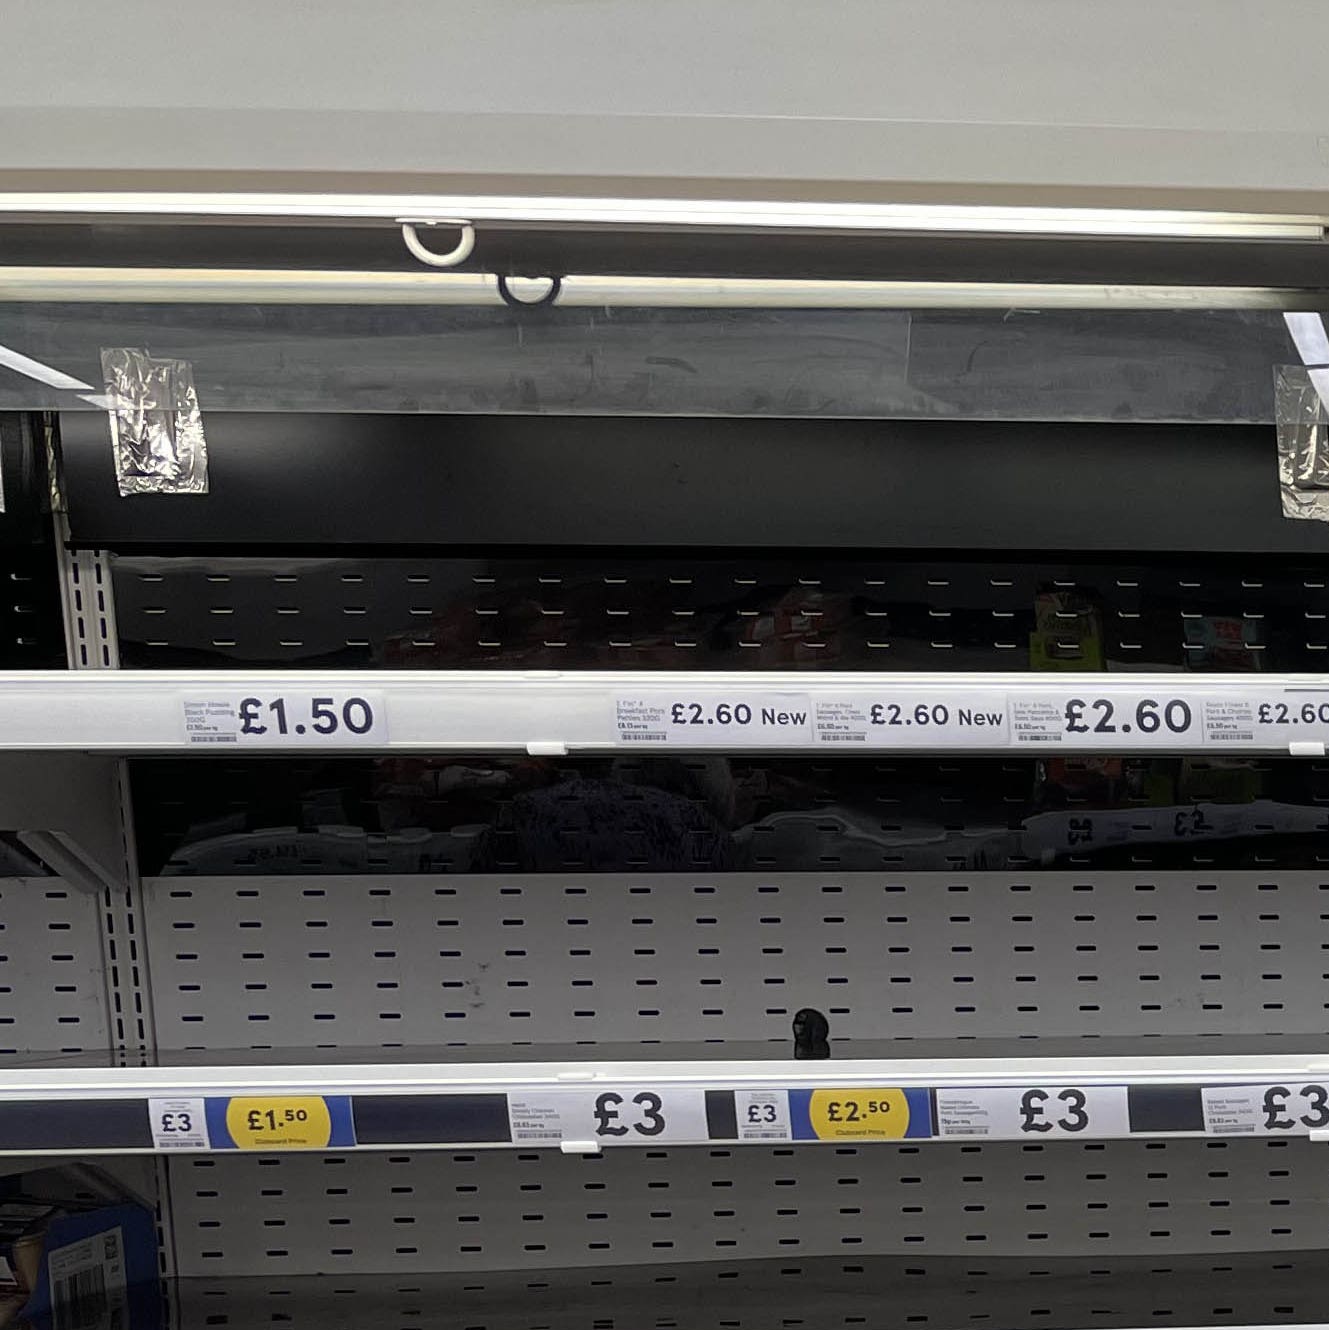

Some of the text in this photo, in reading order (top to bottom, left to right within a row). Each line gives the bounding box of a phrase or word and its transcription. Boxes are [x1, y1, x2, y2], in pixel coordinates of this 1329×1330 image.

[239, 698, 372, 734] £1.50
[672, 704, 751, 724] £2.60
[762, 709, 806, 725] New
[871, 704, 948, 725] £2.60
[959, 709, 1002, 725] New
[1065, 700, 1191, 733] £2.60
[594, 1092, 665, 1136] £3
[748, 1105, 776, 1122] £3
[828, 1101, 889, 1121] £2.50
[1020, 1089, 1088, 1132] £3
[1263, 1085, 1329, 1130] £3
[162, 1114, 191, 1132] £3
[248, 1110, 307, 1130] £1.50
